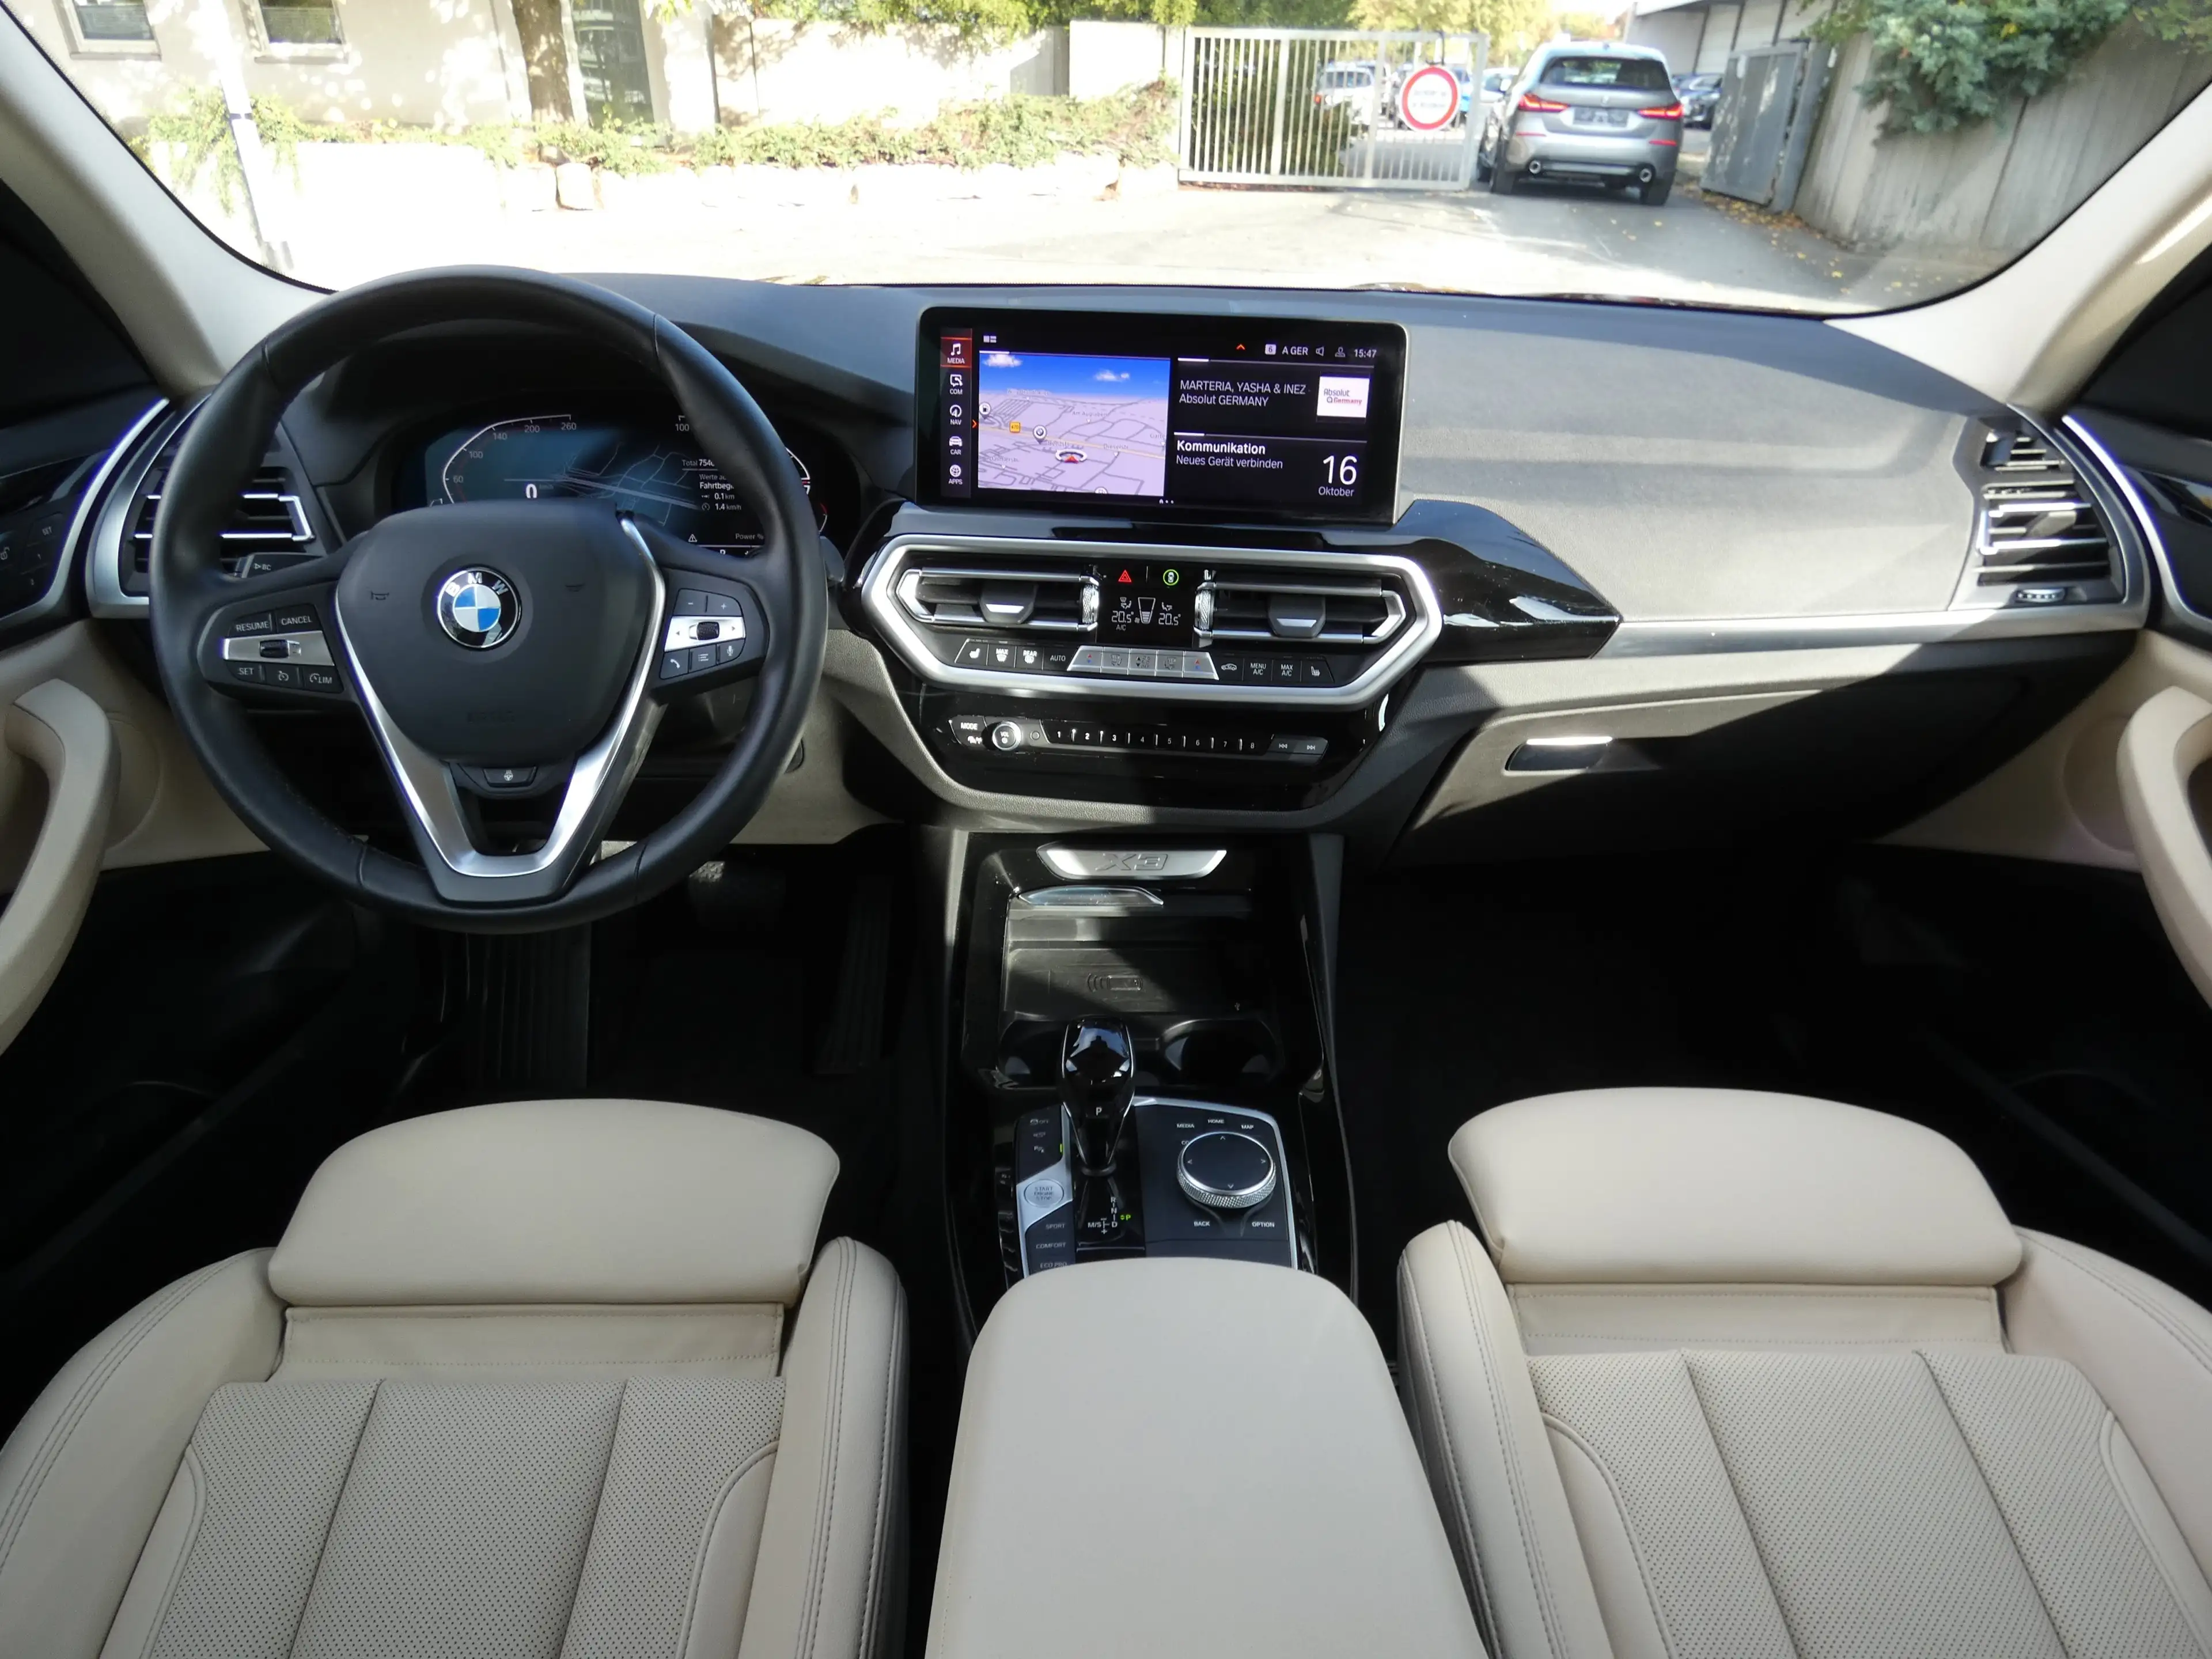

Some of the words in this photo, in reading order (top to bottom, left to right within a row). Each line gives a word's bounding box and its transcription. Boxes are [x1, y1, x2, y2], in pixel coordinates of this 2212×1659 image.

[1282, 346, 1289, 355] A
[1290, 347, 1308, 355] GER
[1354, 349, 1377, 358] 15:47
[1180, 380, 1234, 393] MARTERIA,
[1237, 381, 1271, 393] YASHA
[1273, 383, 1281, 393] &
[1284, 384, 1306, 395] INEZ
[1324, 388, 1350, 397] Absolut
[1179, 393, 1216, 404] Absolut
[1218, 395, 1269, 407] GERMANY
[561, 422, 576, 430] 260
[1177, 440, 1266, 454] Kommunikation
[1176, 455, 1206, 465] Neues
[1208, 456, 1234, 467] Gerät
[1236, 457, 1283, 469] verbinden
[1323, 456, 1357, 485] 16
[1318, 486, 1354, 497] Oktober
[445, 572, 509, 596] BMW
[281, 615, 313, 626] CANCEL
[236, 621, 270, 632] RESUME
[318, 676, 332, 684] LIM
[1095, 853, 1168, 871] X3
[1096, 1107, 1103, 1116] P
